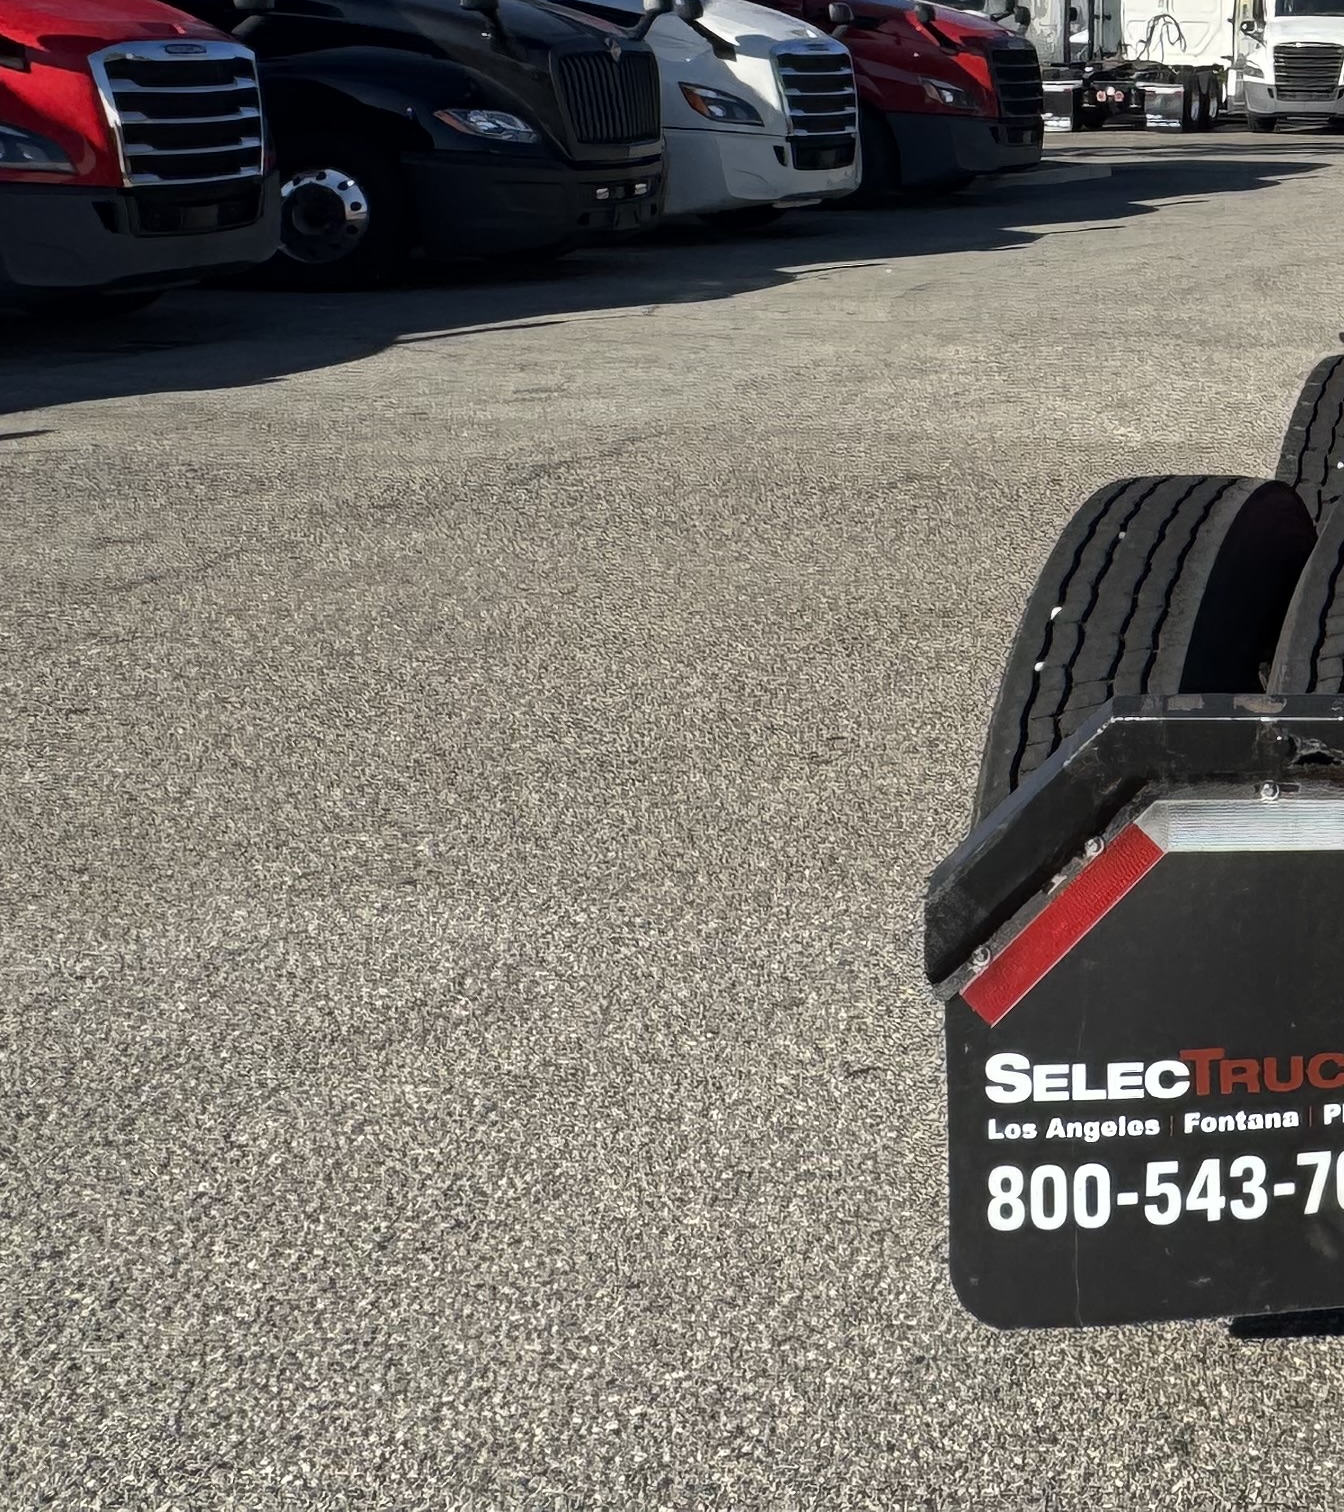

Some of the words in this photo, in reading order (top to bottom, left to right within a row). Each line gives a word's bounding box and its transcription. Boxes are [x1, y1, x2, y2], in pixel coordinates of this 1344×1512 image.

[988, 1118, 1037, 1140] Los
[1046, 1115, 1160, 1143] Angeles
[1184, 1108, 1299, 1134] Fontana
